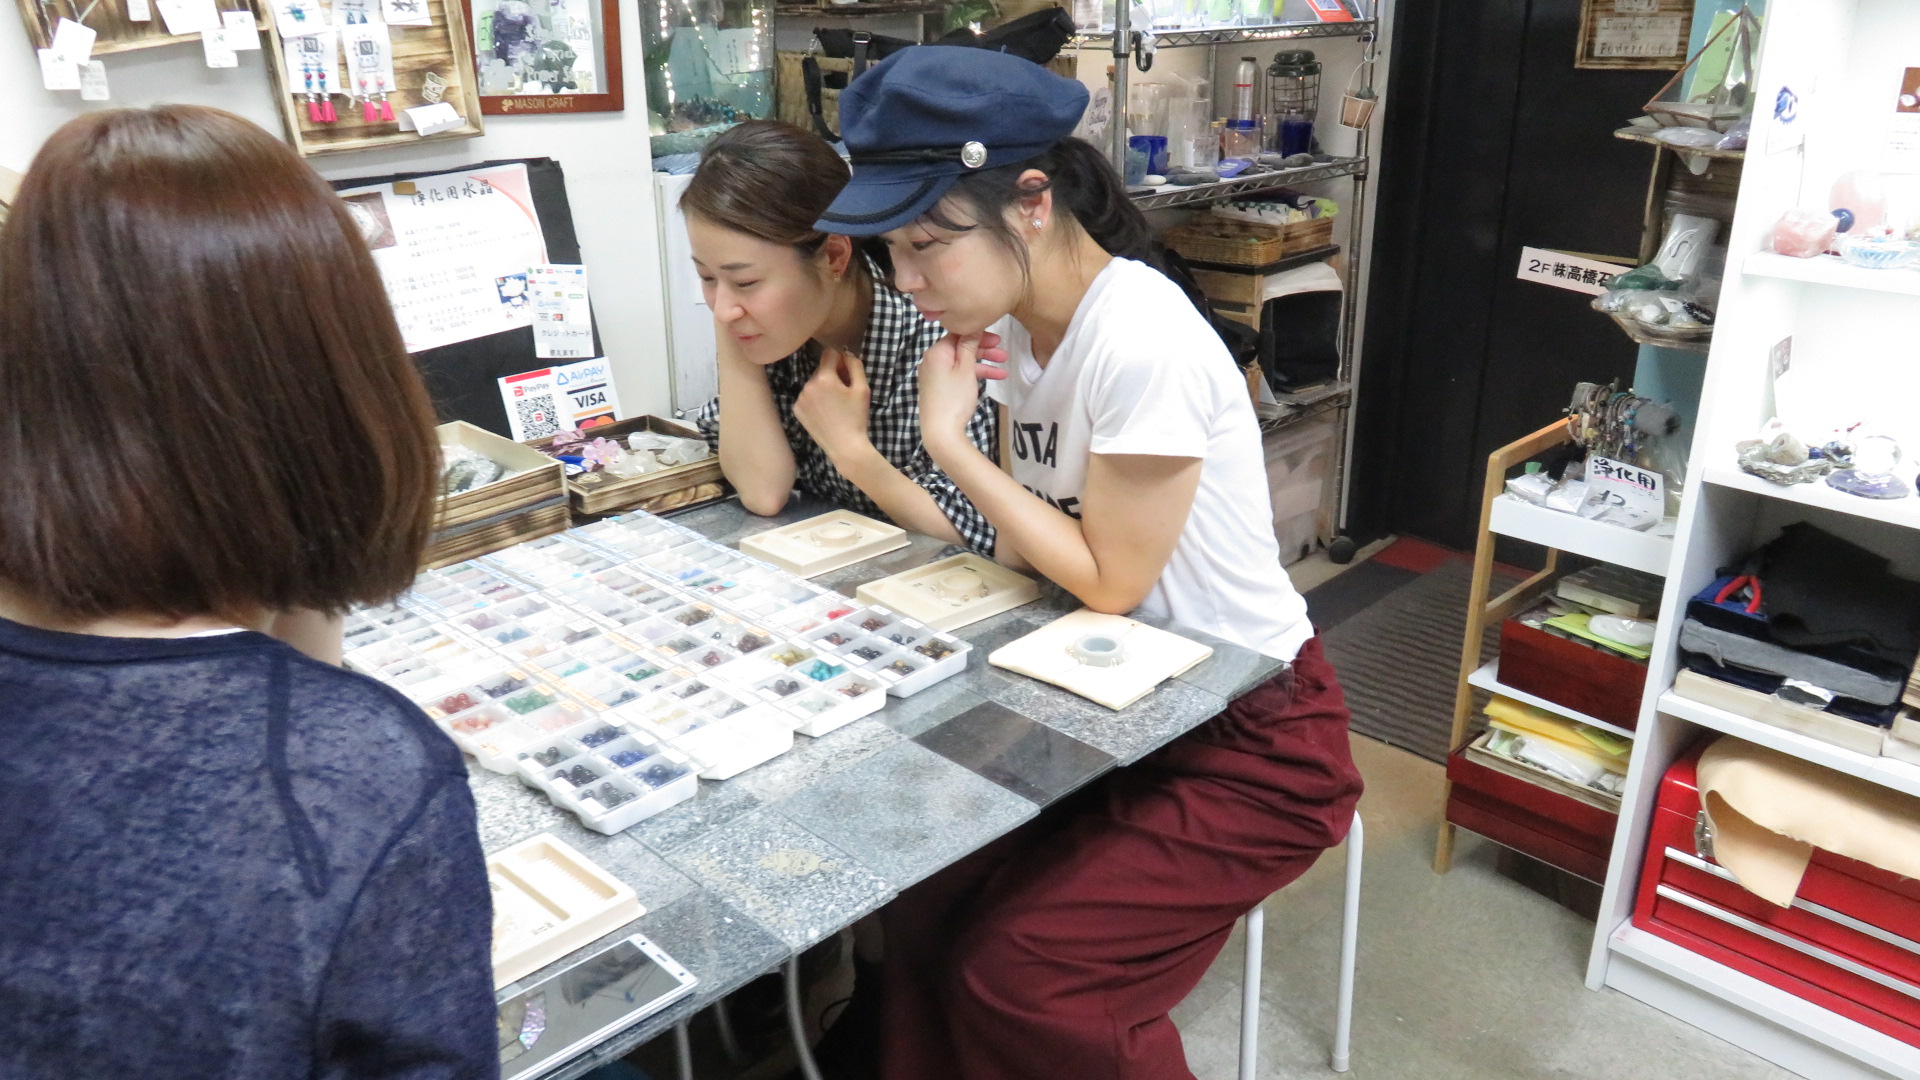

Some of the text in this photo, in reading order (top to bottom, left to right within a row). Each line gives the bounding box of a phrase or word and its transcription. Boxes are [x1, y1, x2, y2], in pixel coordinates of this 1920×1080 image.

[515, 97, 575, 109] MASON CRAFT
[524, 382, 550, 394] PayPay
[574, 391, 607, 409] VISA
